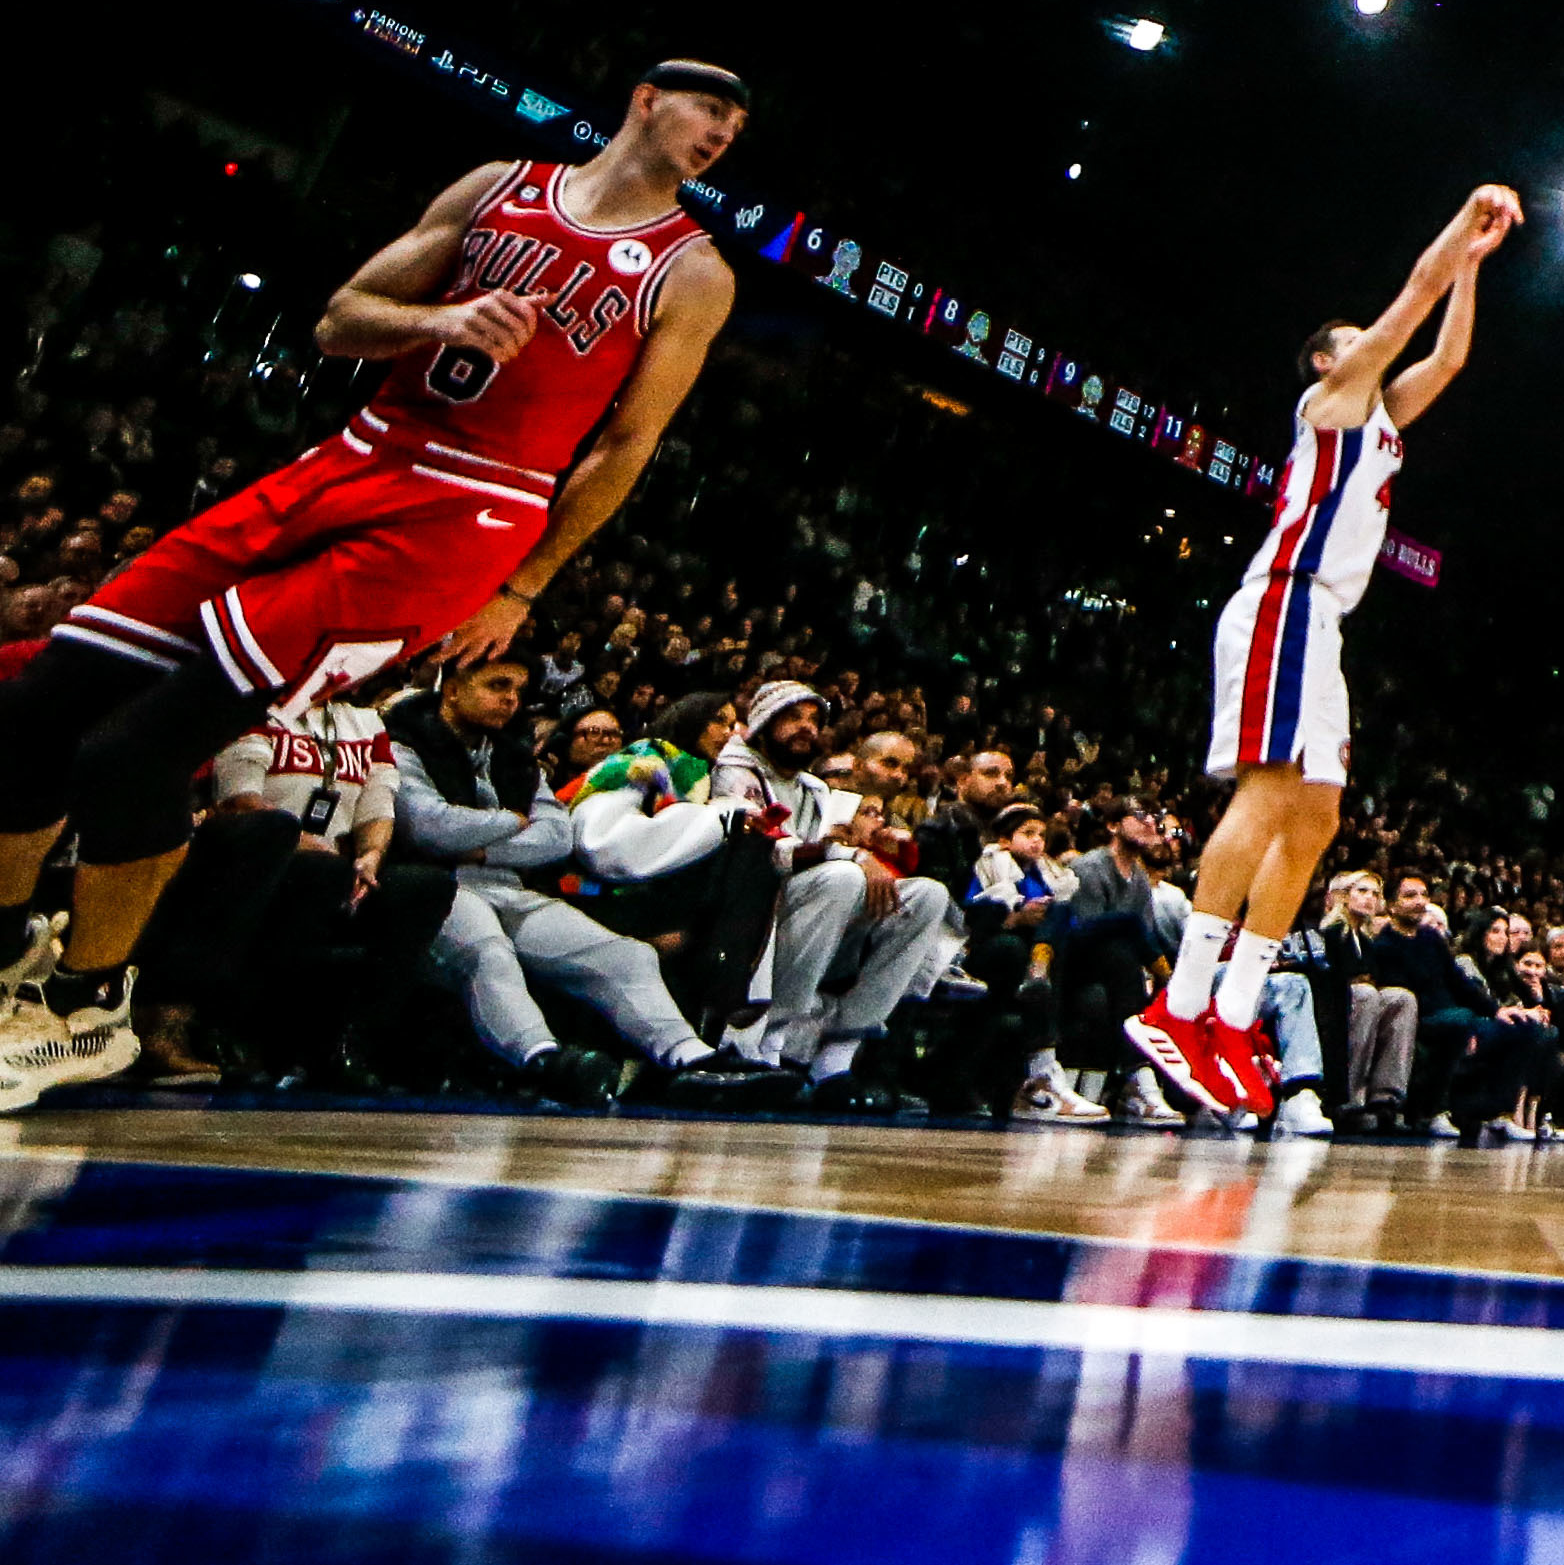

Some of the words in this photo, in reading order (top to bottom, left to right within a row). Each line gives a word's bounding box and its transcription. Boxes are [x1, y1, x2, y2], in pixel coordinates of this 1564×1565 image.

[370, 9, 427, 45] PARIONS
[459, 62, 510, 97] PS5
[807, 228, 822, 250] 6
[878, 264, 907, 289] PTS
[452, 228, 632, 356] BULLS
[871, 288, 897, 312] FLS
[944, 300, 958, 320] 8
[1065, 362, 1076, 382] 9
[1166, 416, 1182, 438] 11
[1258, 464, 1274, 485] 44
